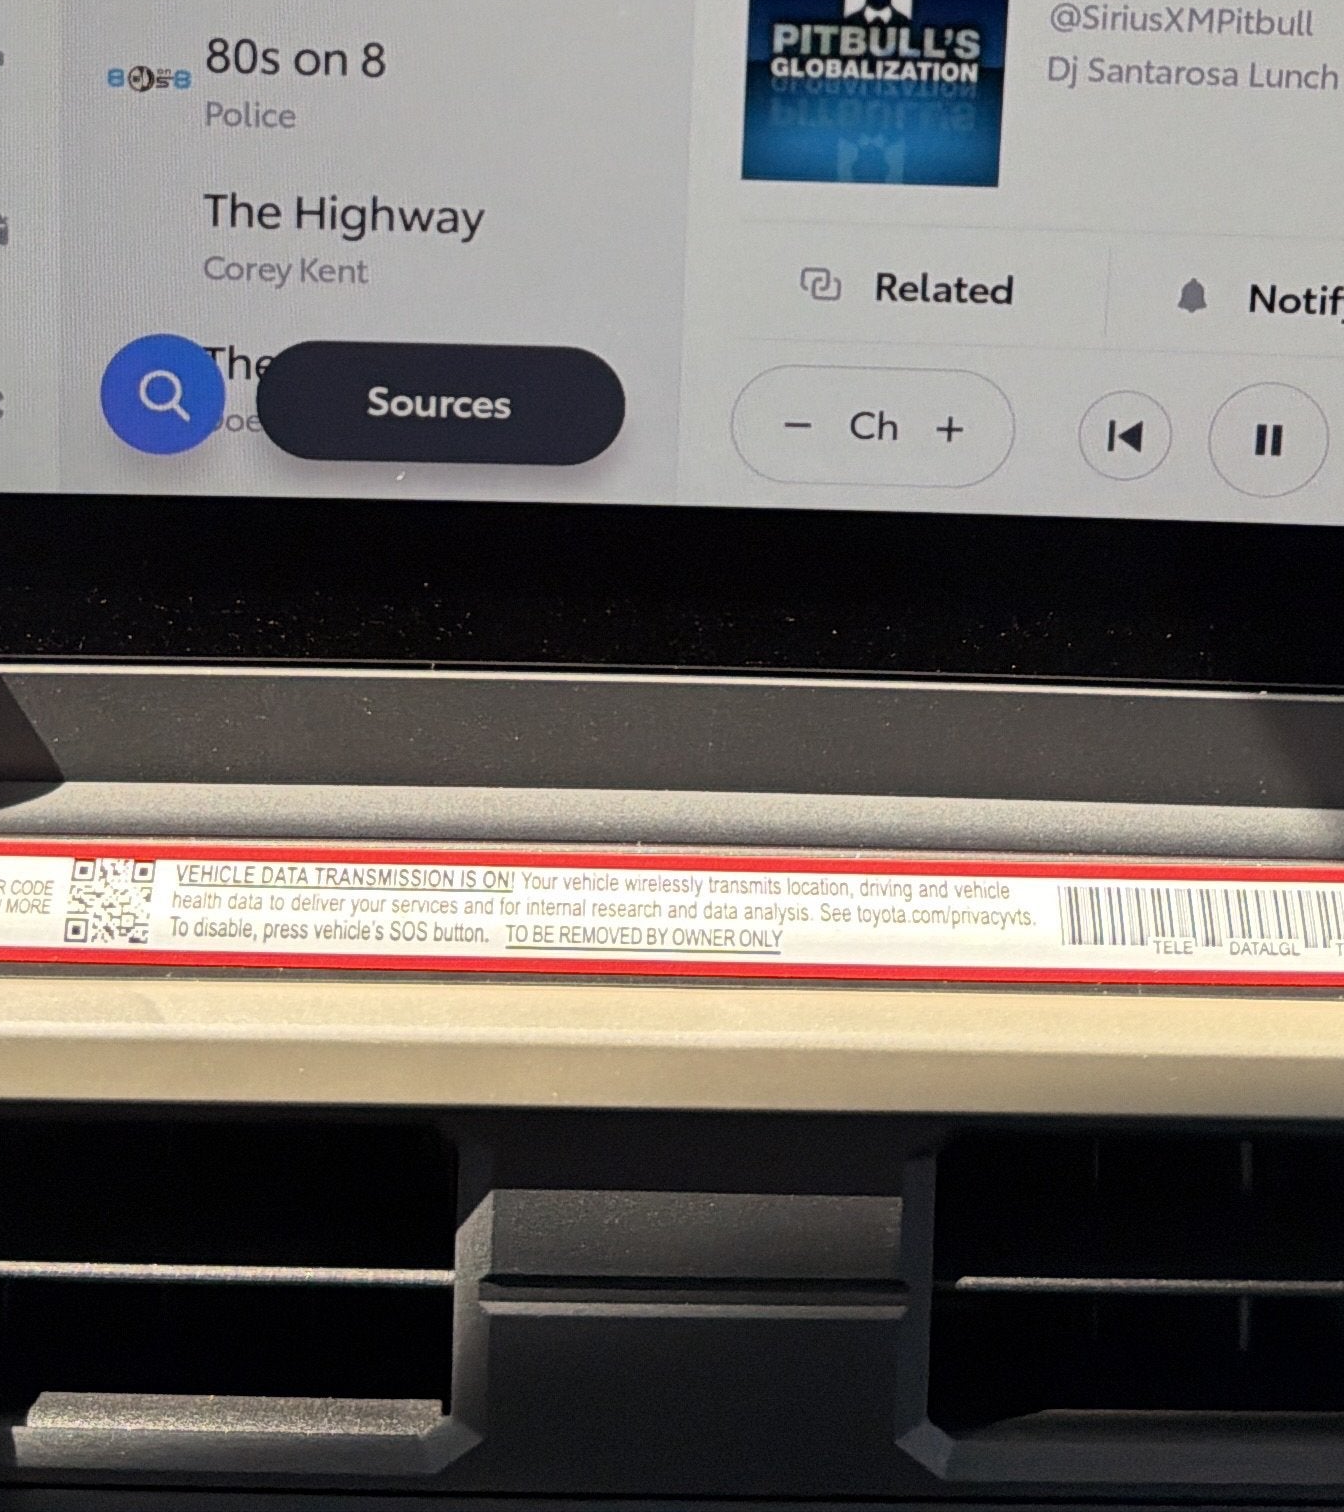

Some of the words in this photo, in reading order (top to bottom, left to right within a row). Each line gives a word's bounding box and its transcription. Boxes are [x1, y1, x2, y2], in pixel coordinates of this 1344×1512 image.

[1050, 2, 1315, 37] @SiriusXMPitbull
[206, 38, 281, 76] 80s
[294, 49, 348, 76] on
[361, 42, 387, 78] 8
[772, 23, 980, 60] PITBULL'S
[770, 57, 979, 83] GLOBALIZATION
[1047, 55, 1078, 89] Dj
[1088, 57, 1239, 88] Santarosa
[1249, 62, 1339, 90] Lunch
[206, 100, 296, 129] Police
[204, 192, 282, 230] The
[296, 194, 486, 244] Highway
[204, 256, 293, 289] Corey
[300, 257, 369, 284] Kent
[875, 272, 1014, 305] Related
[367, 386, 512, 420] Sources
[850, 410, 899, 442] Ch
[10, 879, 55, 896] CODE
[176, 864, 256, 884] VEHICLE
[262, 866, 309, 885] DATA
[315, 867, 455, 888] TRANSMISSION
[461, 869, 477, 888] IS
[482, 870, 515, 889] ON!
[522, 871, 558, 890] Your
[563, 872, 619, 892] vehicle
[625, 874, 703, 897] wirelessly
[709, 876, 782, 895] transmits
[787, 877, 854, 899] location,
[860, 878, 913, 903] driving
[919, 880, 949, 899] and
[954, 881, 1011, 900] vehicle
[6, 897, 52, 914] MORE
[172, 891, 222, 910] health
[227, 893, 263, 910] data
[270, 894, 285, 911] to
[291, 894, 345, 913] deliver
[350, 897, 386, 917] your
[392, 897, 458, 915] services
[464, 897, 494, 915] and
[500, 896, 521, 916] for
[526, 898, 586, 917] internal
[592, 899, 662, 918] research
[668, 900, 698, 919] and
[703, 901, 739, 920] data
[744, 902, 815, 926] analysis.
[820, 902, 852, 922] See
[170, 915, 189, 937] To
[194, 916, 258, 941] disable,
[263, 921, 309, 943] press
[314, 919, 385, 941] vehicle's
[389, 920, 428, 942] SOS
[433, 922, 490, 943] button.
[505, 924, 528, 942] TO
[533, 925, 555, 943] BE
[559, 925, 643, 945] REMOVED
[647, 926, 669, 945] BY
[672, 927, 735, 947] OWNER
[739, 928, 784, 948] ONLY
[1153, 939, 1194, 955] TELE
[1229, 940, 1301, 957] DATALGL
